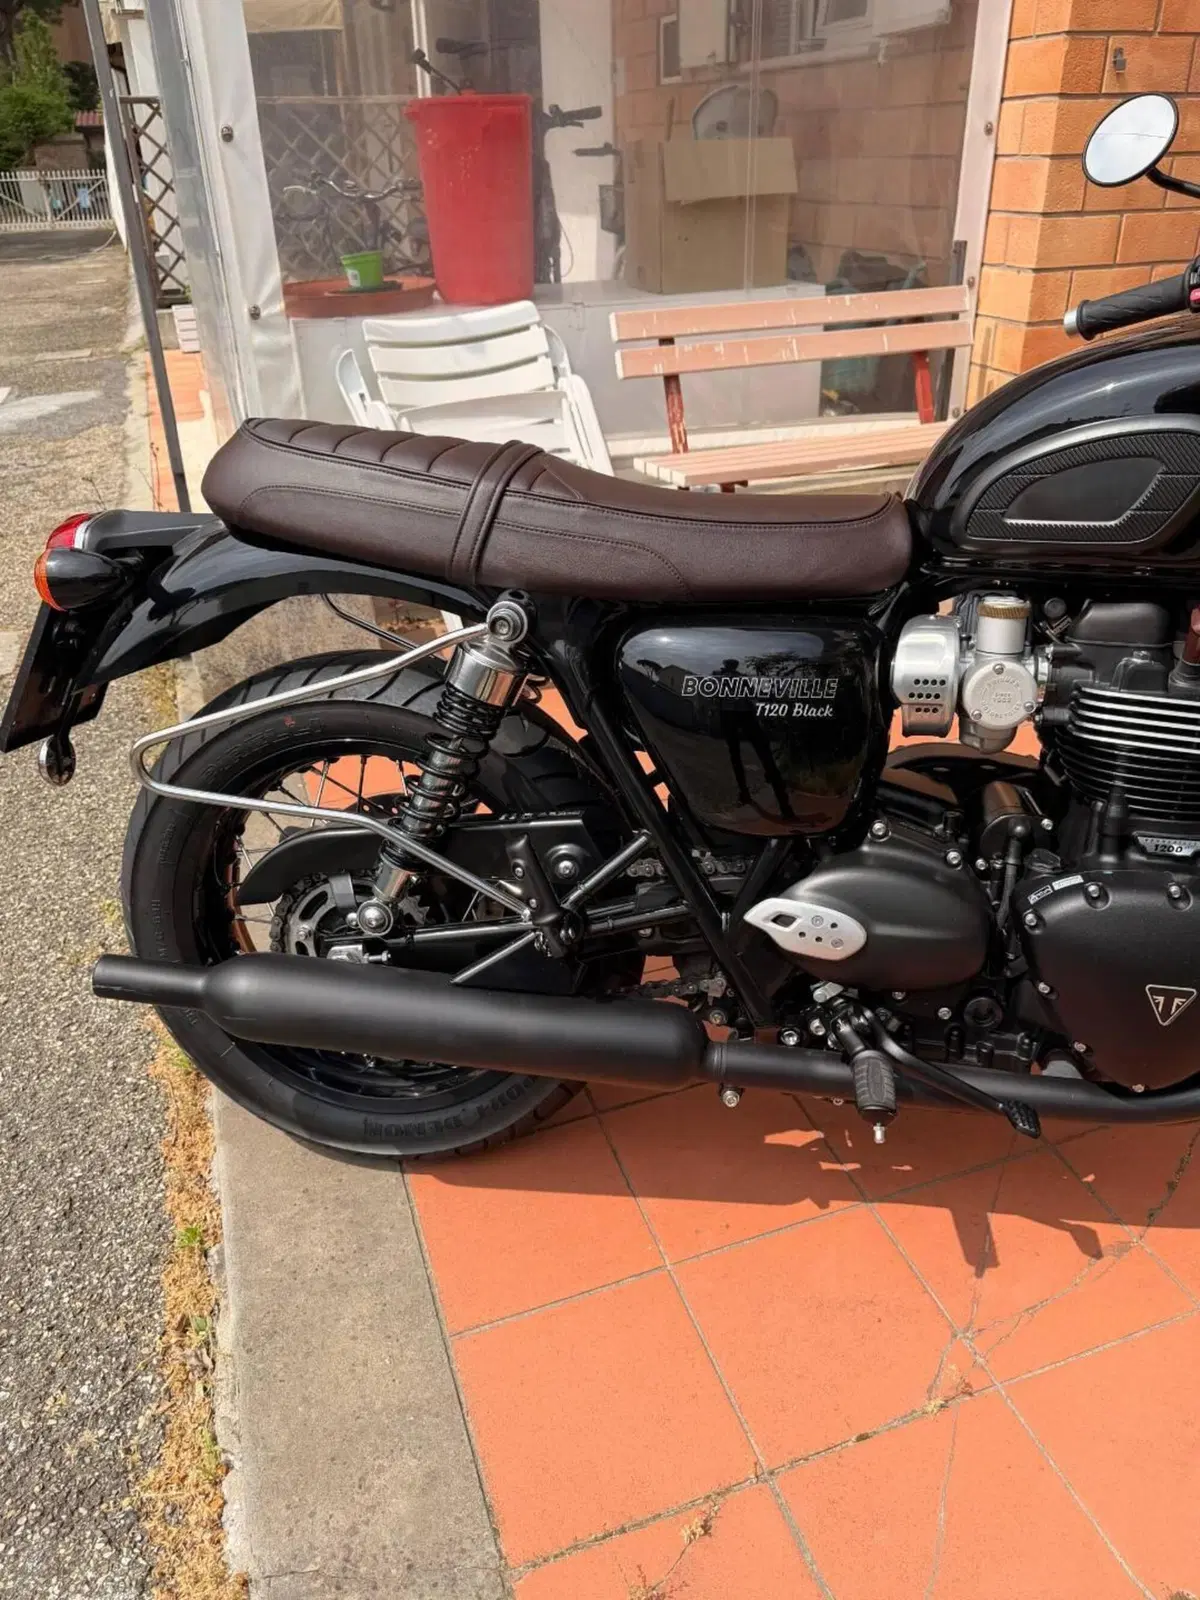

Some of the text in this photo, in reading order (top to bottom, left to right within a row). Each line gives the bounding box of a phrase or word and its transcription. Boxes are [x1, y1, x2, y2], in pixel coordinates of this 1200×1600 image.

[681, 675, 839, 699] BONNEVILLE
[755, 702, 834, 717] T120 Black
[1154, 843, 1183, 853] 1200
